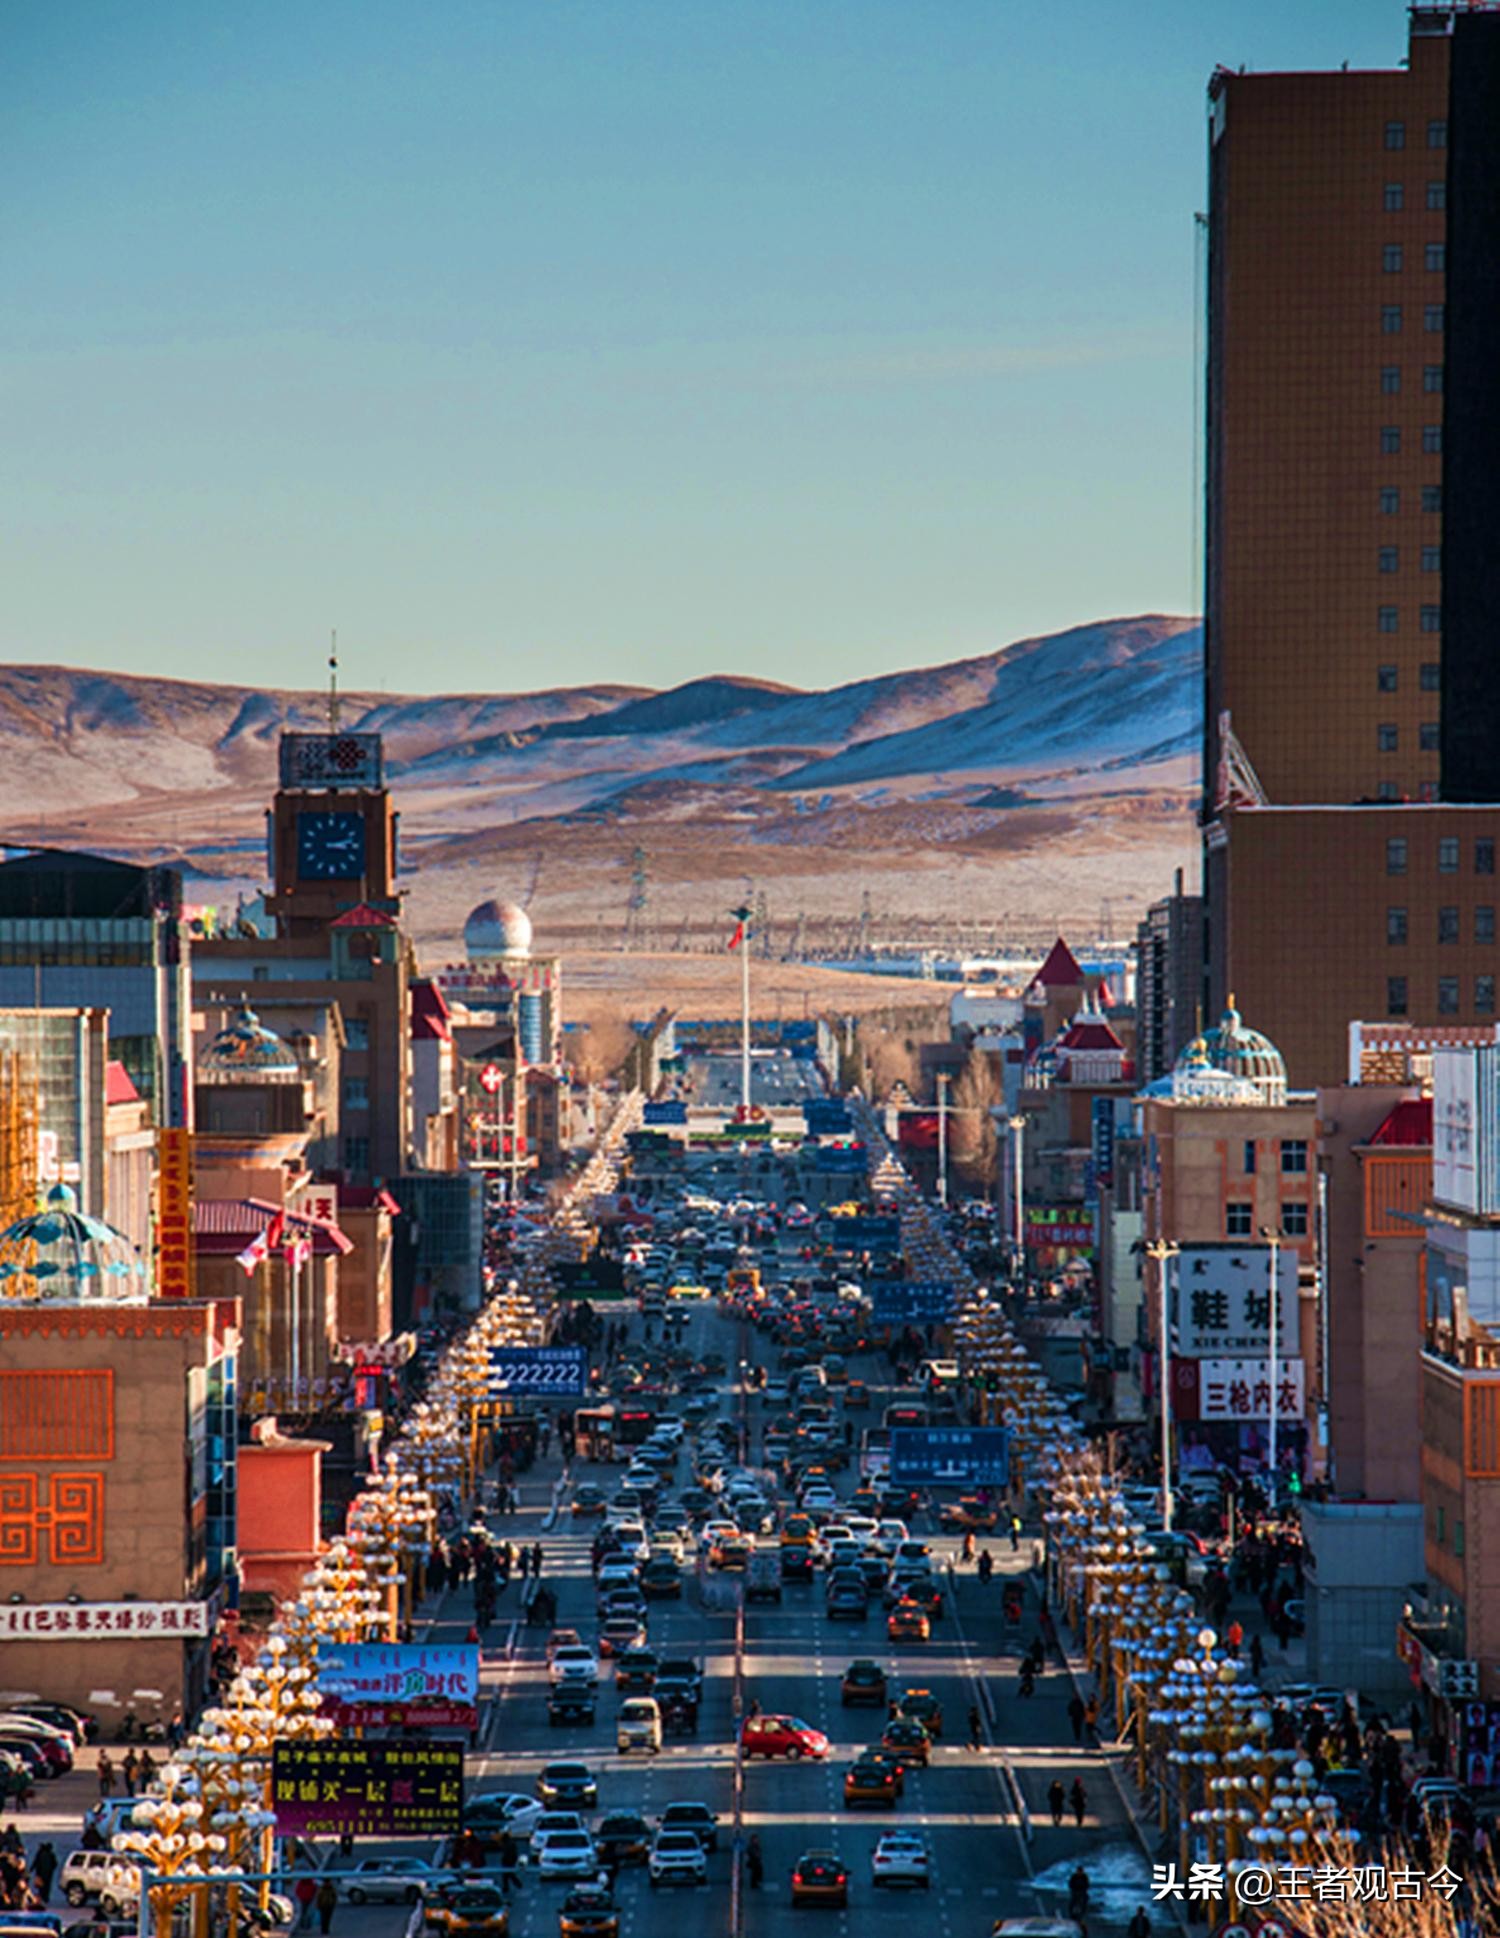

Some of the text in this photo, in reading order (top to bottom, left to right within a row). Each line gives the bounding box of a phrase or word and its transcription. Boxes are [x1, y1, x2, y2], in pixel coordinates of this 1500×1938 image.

[1190, 1289, 1284, 1331] 鞋城
[1207, 1378, 1298, 1414] 三枪内衣
